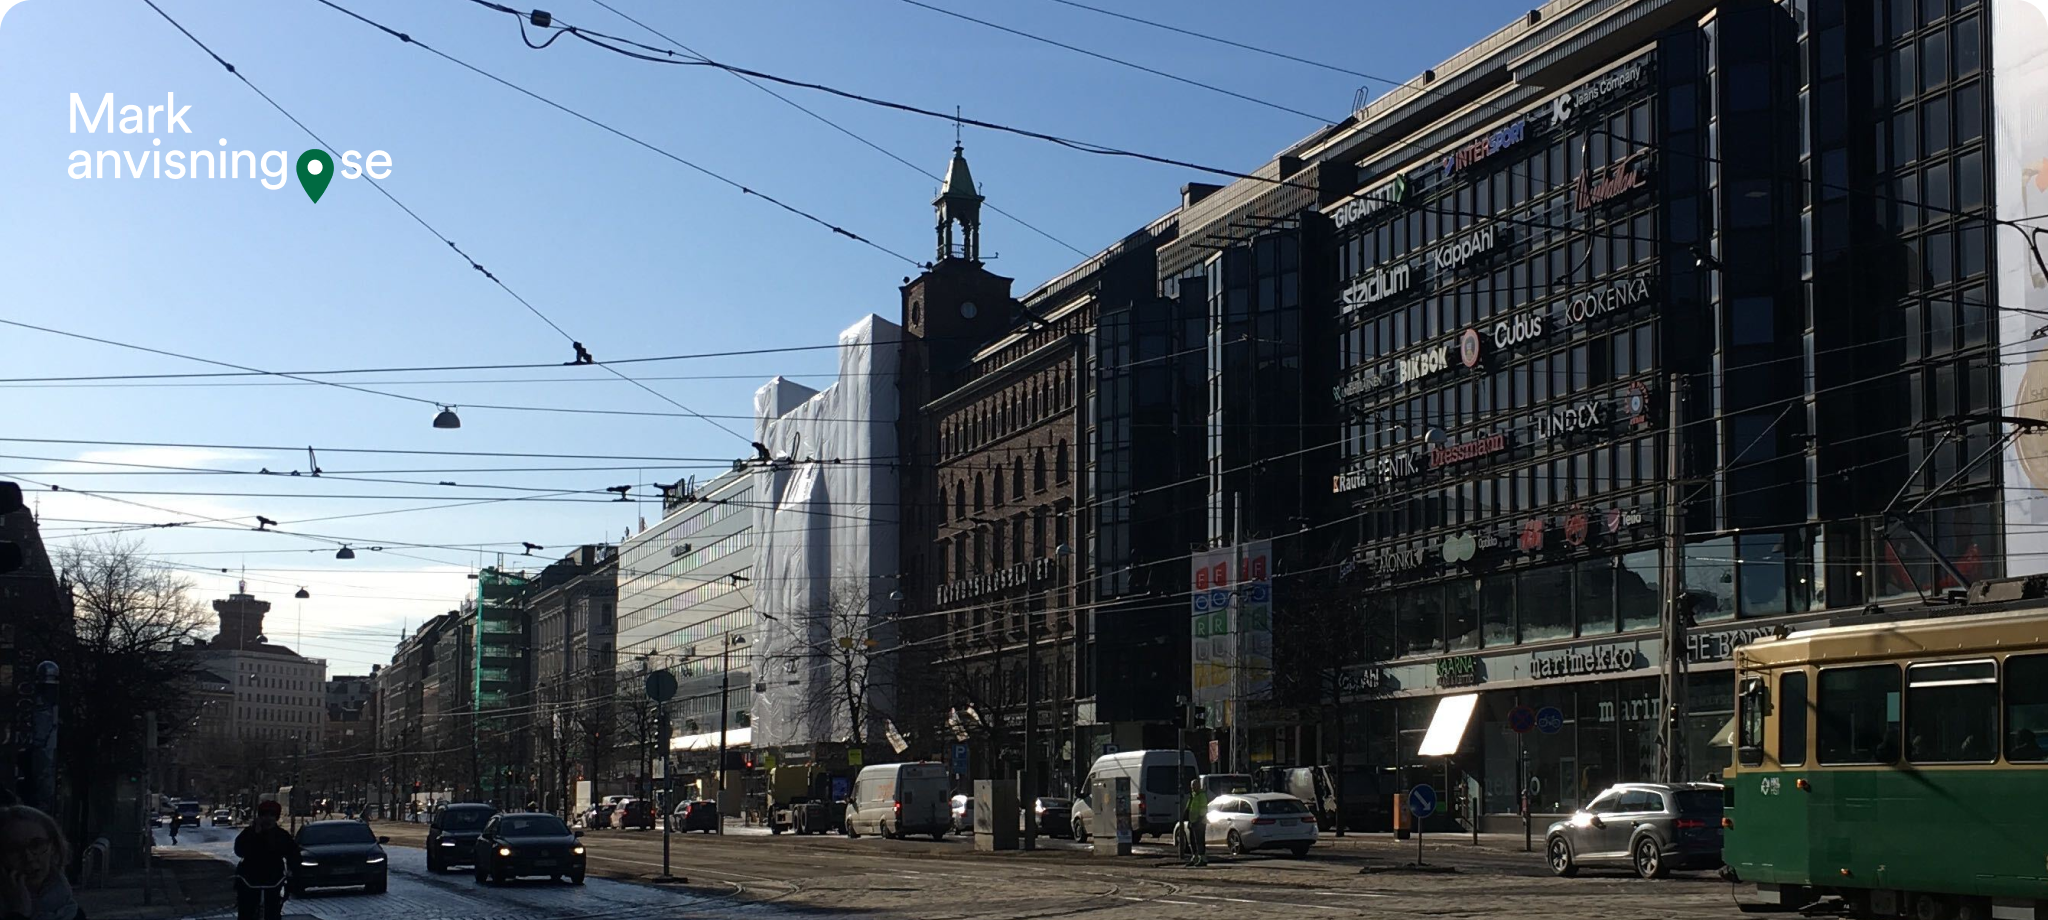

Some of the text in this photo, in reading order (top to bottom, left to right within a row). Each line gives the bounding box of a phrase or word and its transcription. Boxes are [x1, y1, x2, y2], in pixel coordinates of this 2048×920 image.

[1551, 65, 1641, 126] JC Jeans Company
[1455, 120, 1525, 171] INTERSPORT
[1335, 179, 1397, 230] GIGANTTI
[1434, 231, 1494, 272] KappAhl
[1342, 264, 1410, 314] stadium
[1494, 314, 1543, 350] Cubus
[1398, 346, 1448, 384] BIKBOK
[1429, 432, 1505, 468] Dressmann
[1621, 510, 1642, 527] Telia
[1530, 646, 1634, 679] marimekko
[955, 744, 965, 759] P
